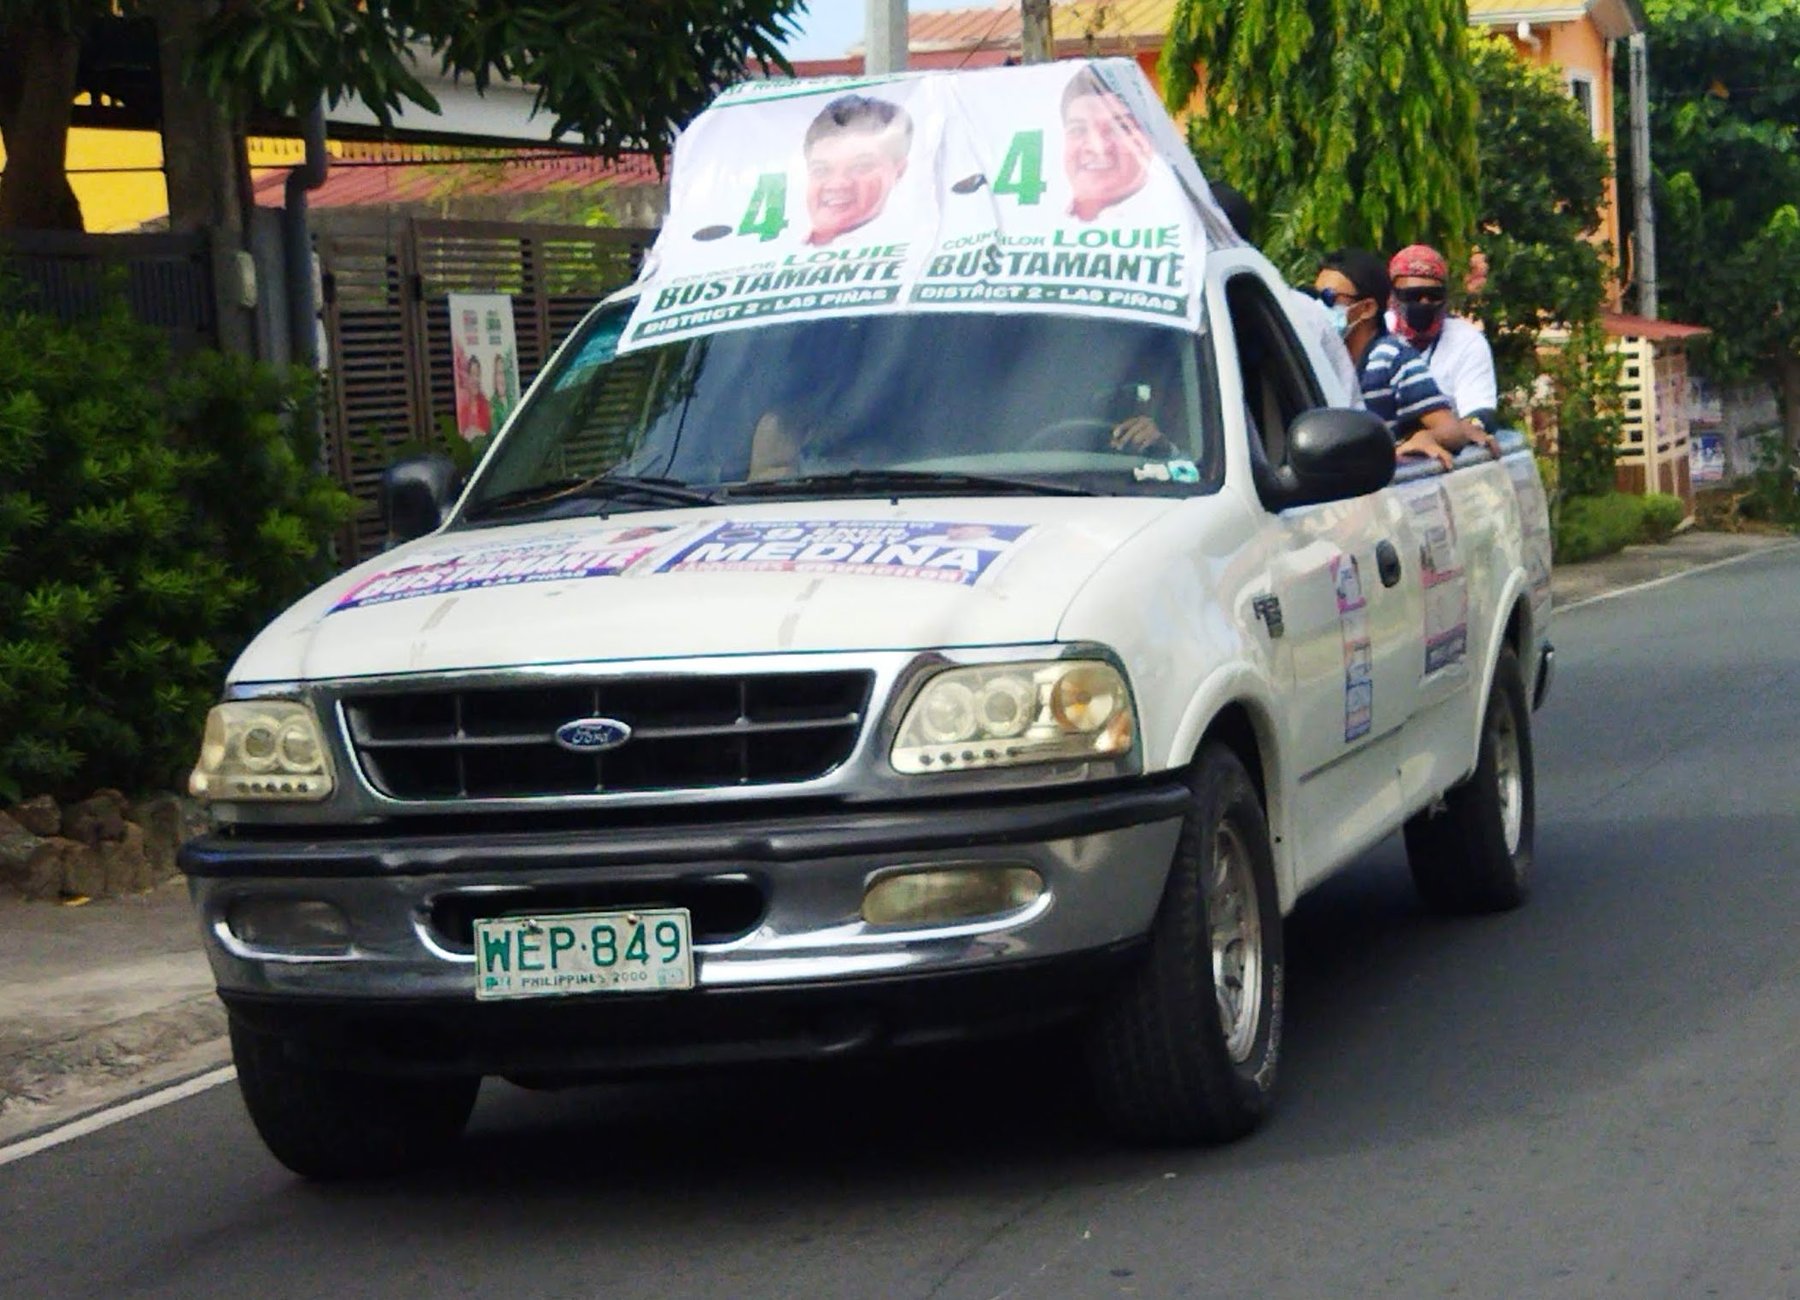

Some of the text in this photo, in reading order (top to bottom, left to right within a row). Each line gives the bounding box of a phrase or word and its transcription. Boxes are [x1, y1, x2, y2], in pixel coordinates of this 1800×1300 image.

[992, 129, 1047, 206] 4
[737, 172, 789, 243] 4
[781, 242, 911, 267] LOUIE
[1052, 224, 1181, 250] LOUIE
[926, 244, 1185, 288] BUSTAMANTE
[653, 260, 902, 313] BUSTAMANTE
[920, 284, 1025, 300] DISTRICT
[1026, 285, 1043, 299] 2
[1059, 287, 1104, 302] LAS
[643, 306, 738, 335] DISTRICT
[743, 301, 761, 315] 2
[775, 295, 817, 311] LAS
[693, 540, 980, 573] MEDINA
[521, 973, 606, 987] PHILIPPINES
